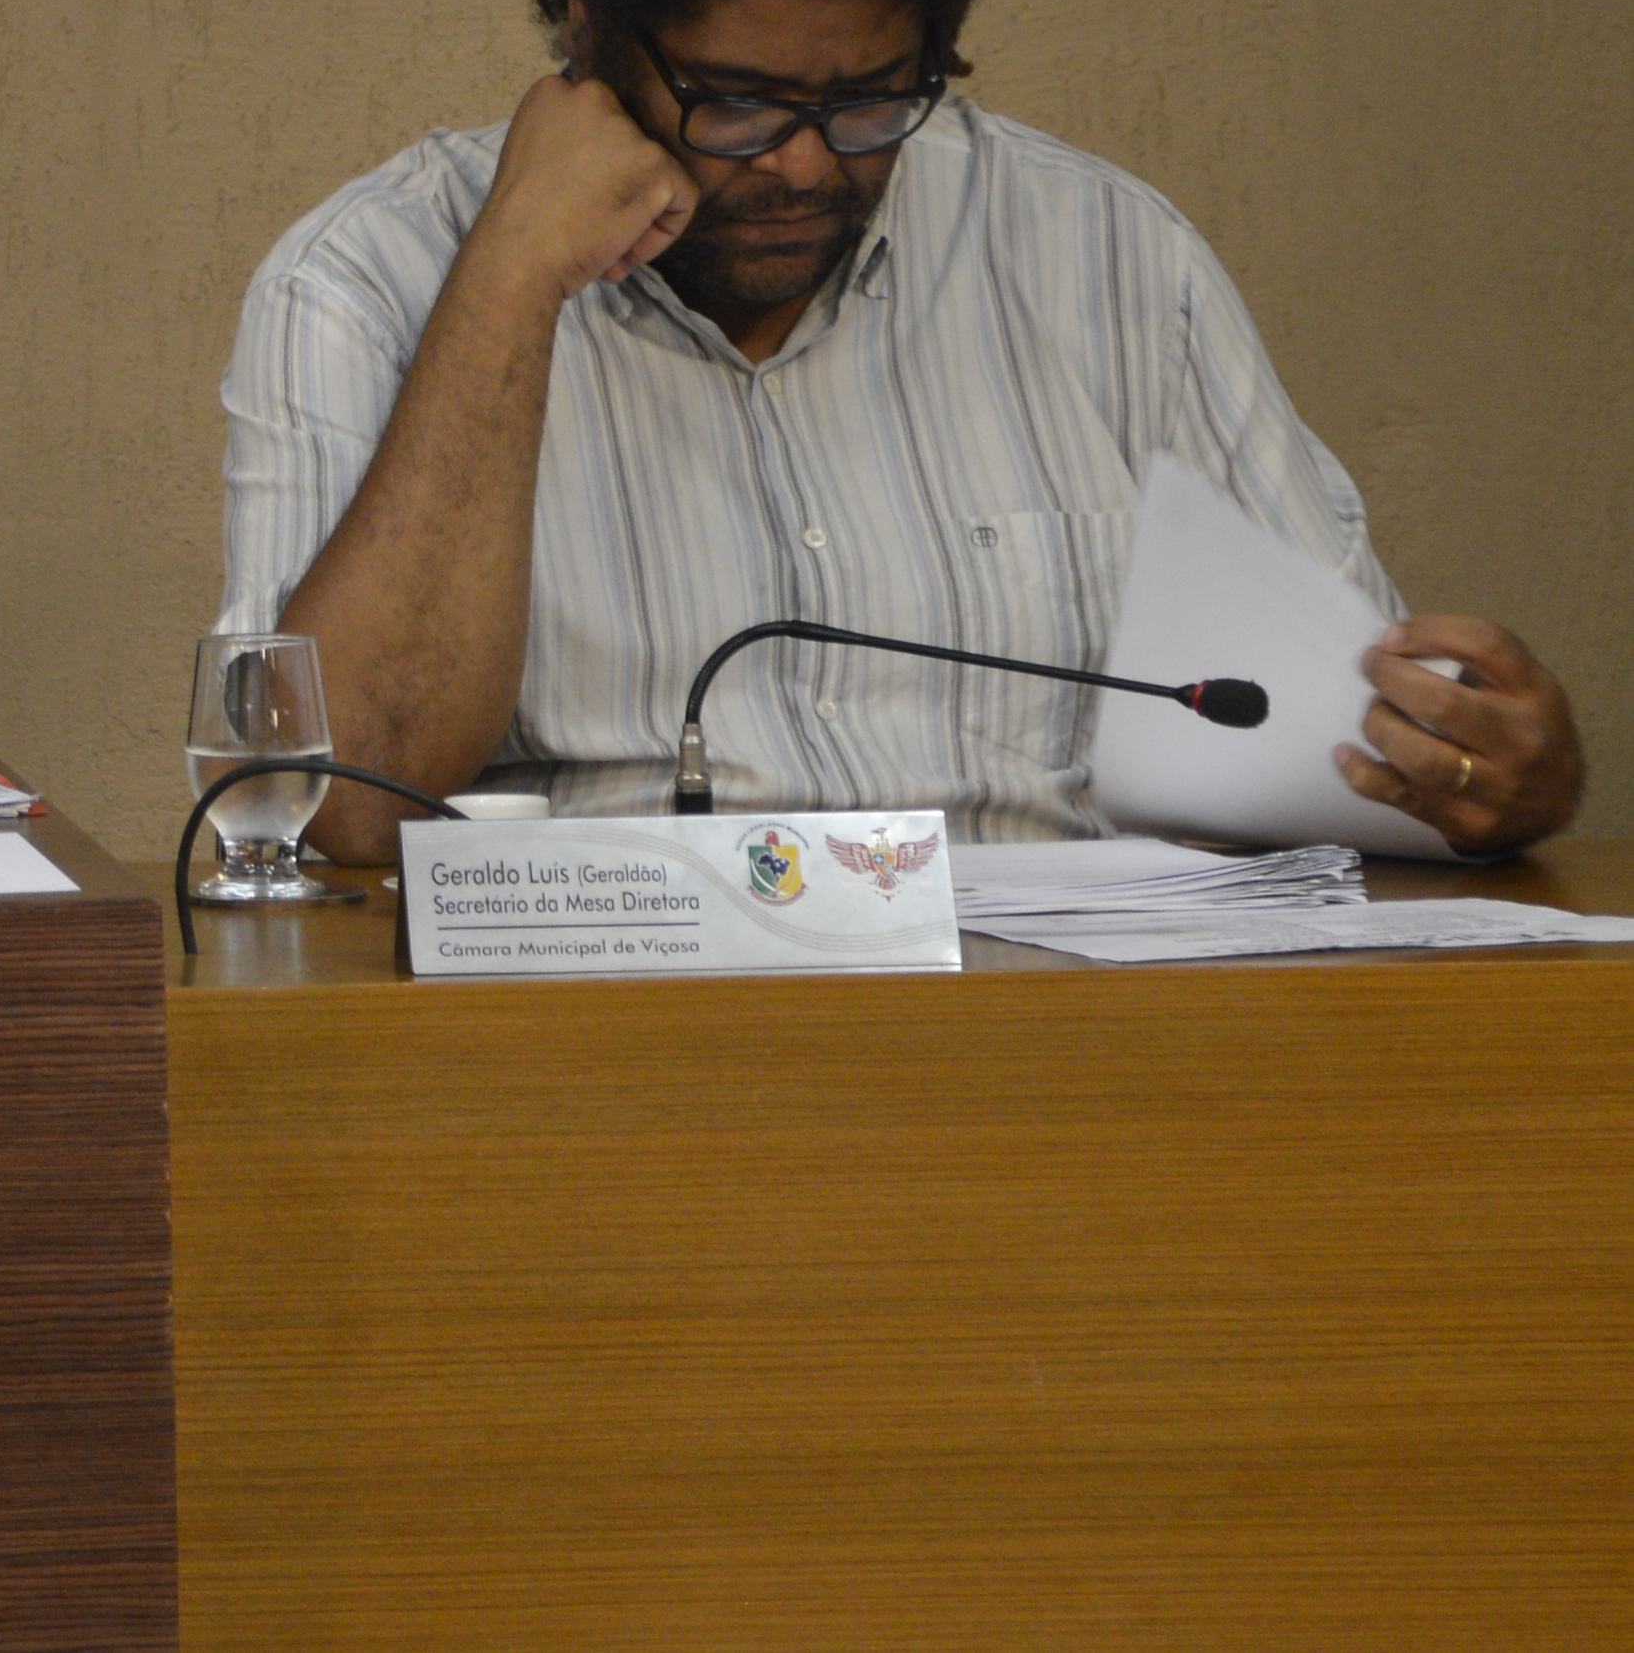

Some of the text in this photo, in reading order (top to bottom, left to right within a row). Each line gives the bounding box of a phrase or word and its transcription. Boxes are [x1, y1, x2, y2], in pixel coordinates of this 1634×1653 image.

[431, 861, 667, 887] Geraldo Luís (Geraldão)
[433, 892, 700, 915] Secretário da Mesa Diretora
[439, 939, 700, 958] Câmara Municipal de Viçosa
